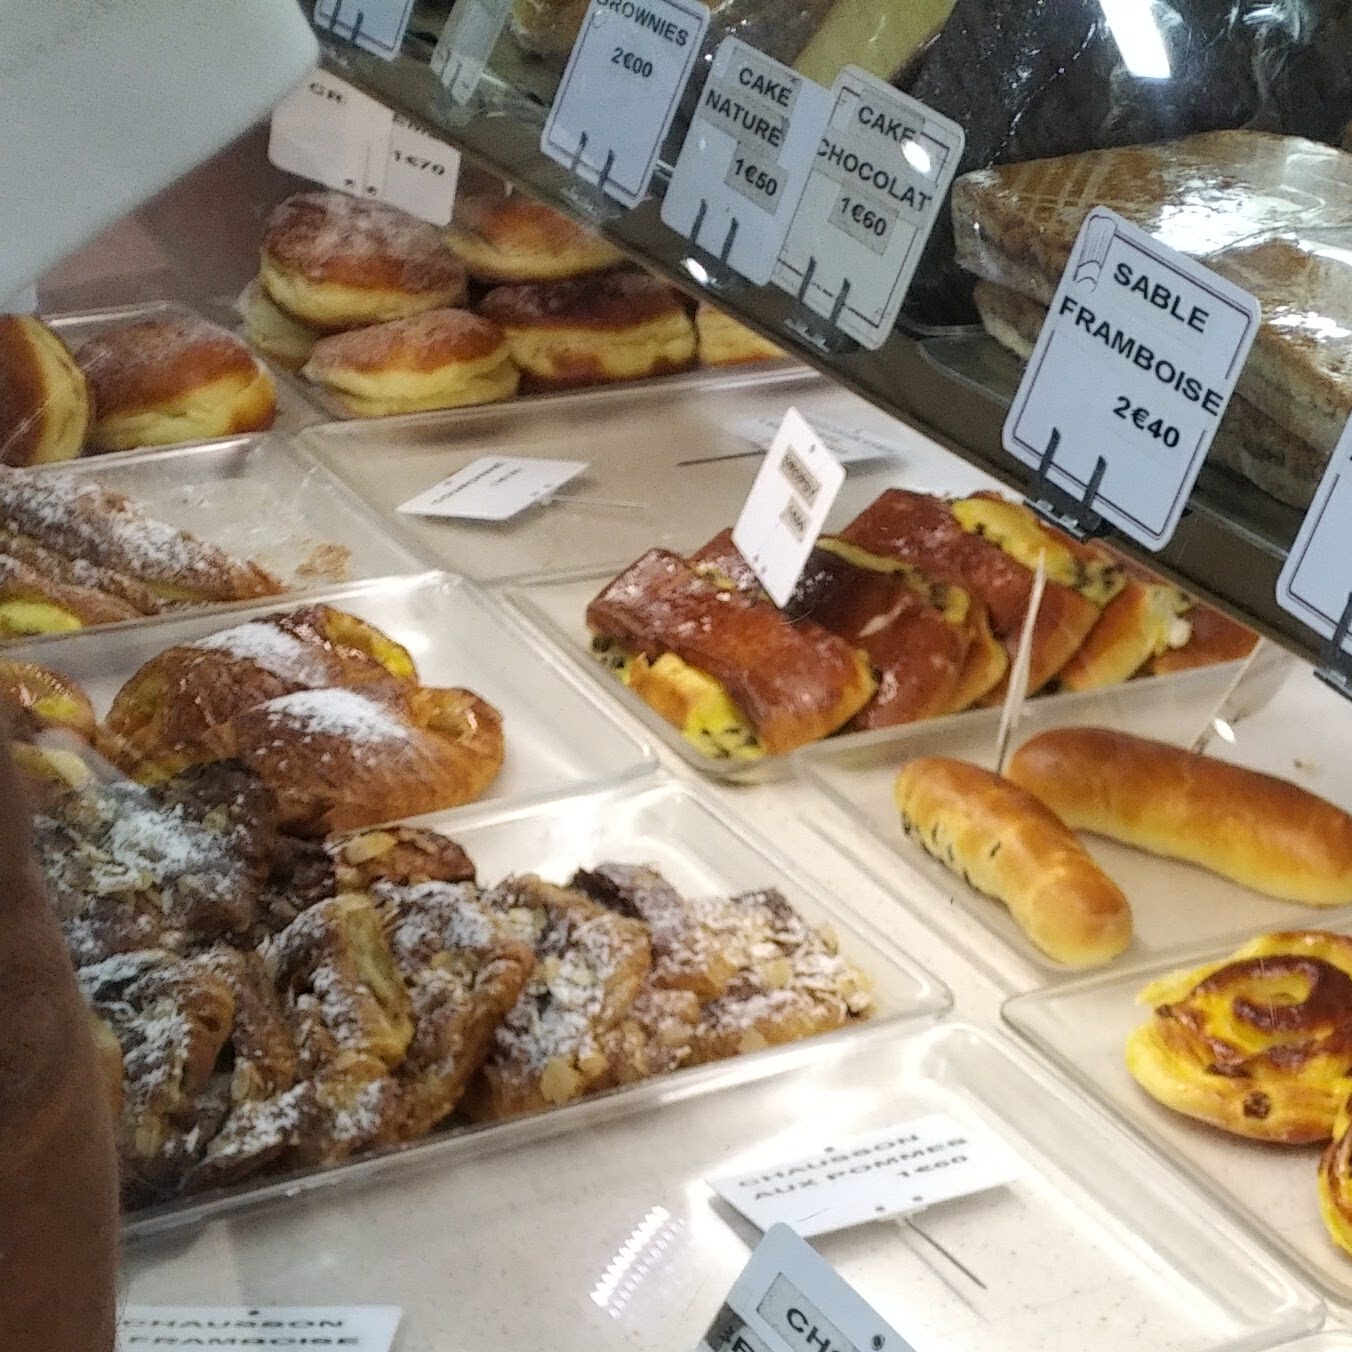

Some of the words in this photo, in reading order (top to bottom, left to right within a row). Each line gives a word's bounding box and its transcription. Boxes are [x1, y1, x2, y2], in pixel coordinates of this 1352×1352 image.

[611, 47, 653, 78] 2€00
[739, 67, 793, 107] CAKE
[705, 89, 784, 148] NATURE
[858, 105, 916, 145] CAKE
[734, 159, 778, 197] 1€50
[816, 138, 932, 212] CHOCOLAT
[841, 197, 887, 236] 1€60
[1113, 262, 1210, 334] SABLE
[1059, 296, 1224, 417] FRAMBOISE
[1113, 396, 1180, 449] 2€40
[738, 1133, 920, 1188] CHAUSSON
[754, 1177, 819, 1200] AUX
